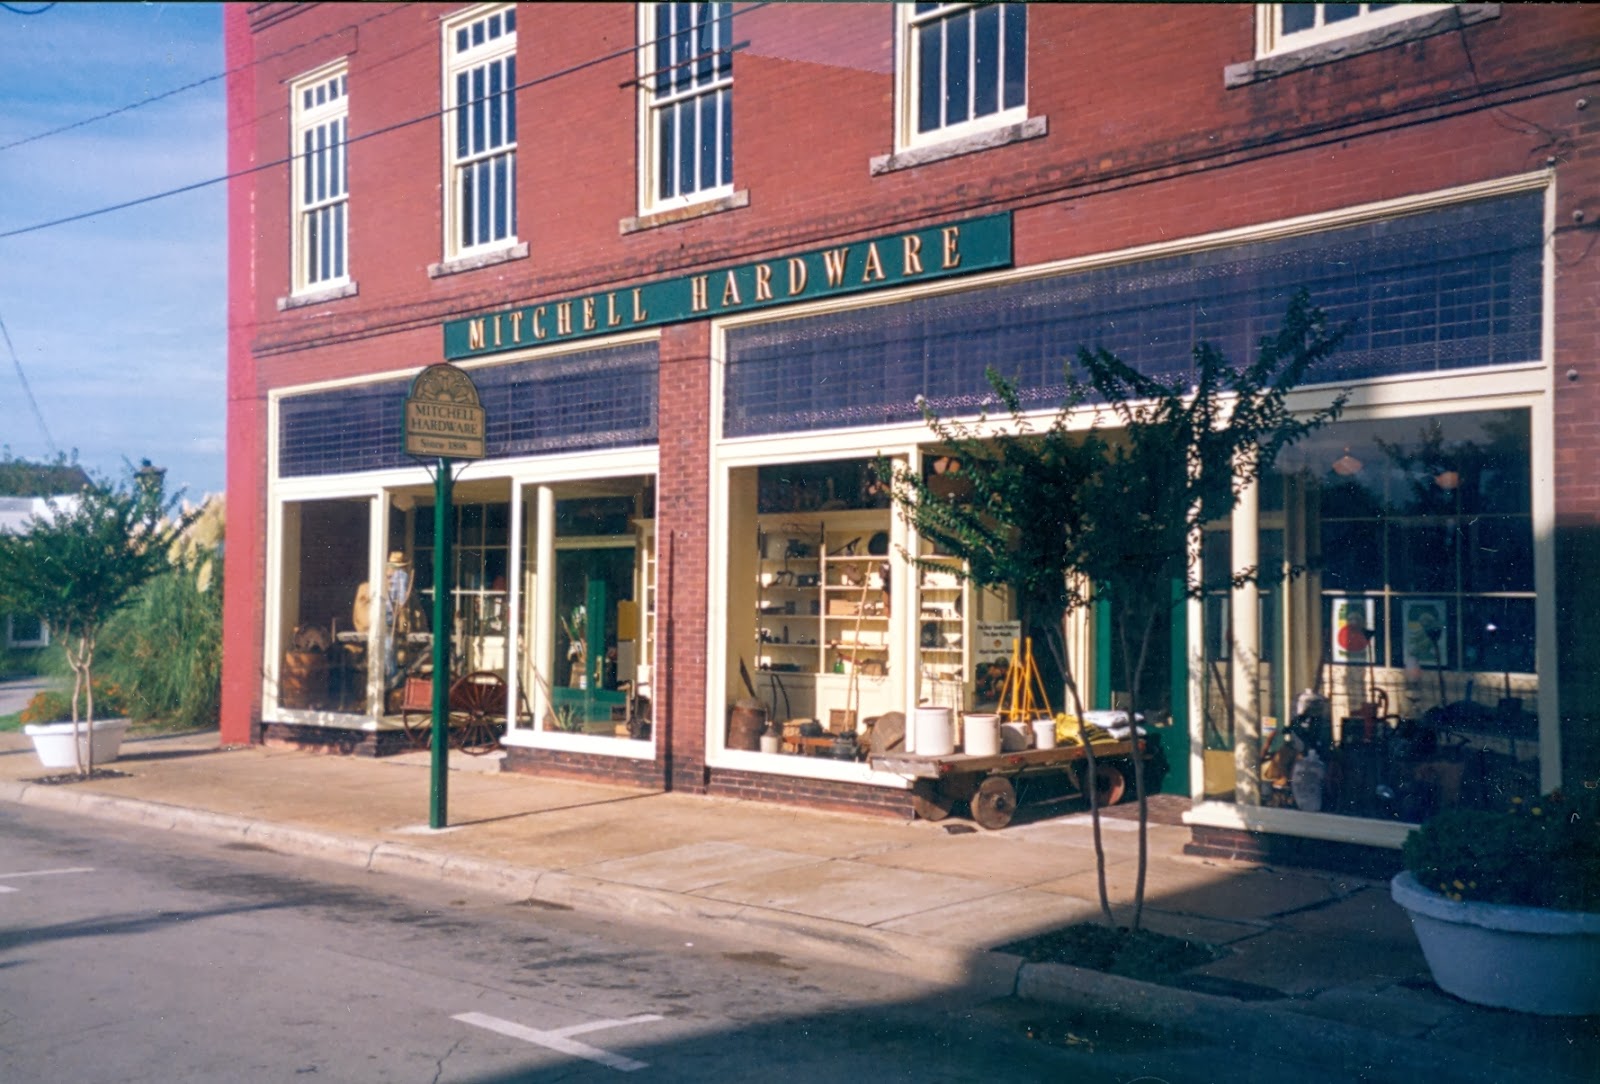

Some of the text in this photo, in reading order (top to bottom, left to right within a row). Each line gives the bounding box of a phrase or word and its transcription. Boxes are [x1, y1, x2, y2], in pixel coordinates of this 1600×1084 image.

[469, 226, 961, 350] MITCHELL HARDWARE
[415, 404, 474, 421] MITCHELL
[411, 418, 478, 434] HARDWARE
